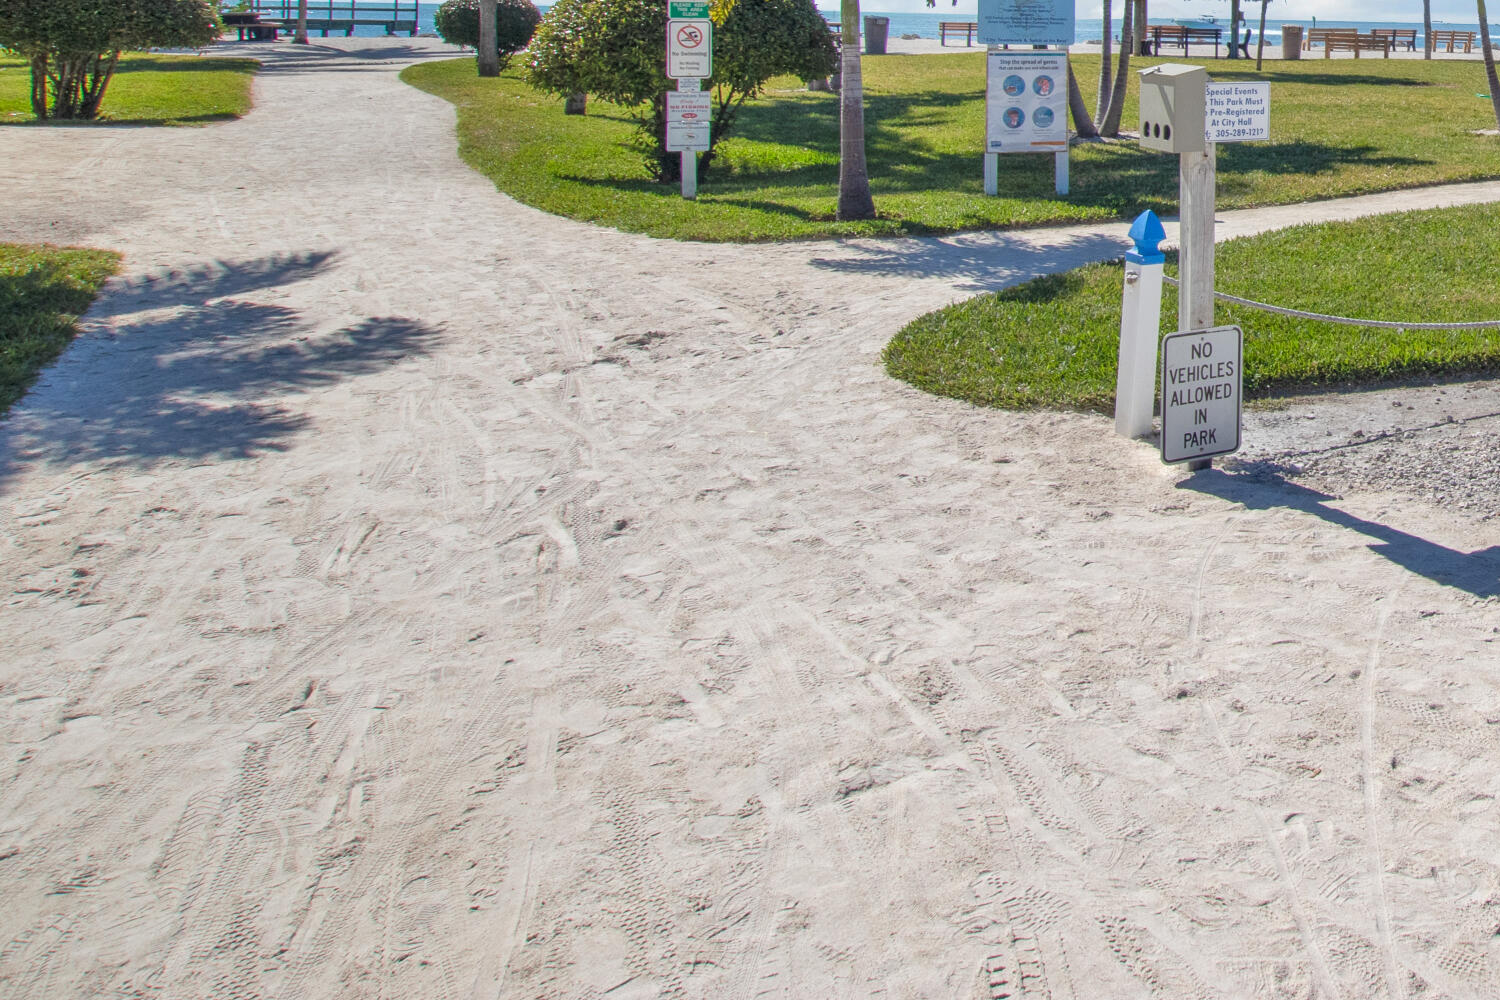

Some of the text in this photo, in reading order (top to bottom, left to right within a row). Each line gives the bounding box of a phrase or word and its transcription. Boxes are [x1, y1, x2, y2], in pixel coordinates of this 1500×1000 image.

[1206, 88, 1232, 97] Special
[1209, 98, 1225, 106] This
[1245, 97, 1263, 105] Must
[1210, 107, 1265, 117] Pre-Registered
[1221, 118, 1235, 127] City
[1237, 117, 1252, 126] Hall
[1191, 342, 1213, 359] NO
[1169, 360, 1234, 385] VEHICLES
[1170, 382, 1232, 408] ALLOWED
[1194, 407, 1208, 425] IN
[1183, 428, 1217, 449] PARK
